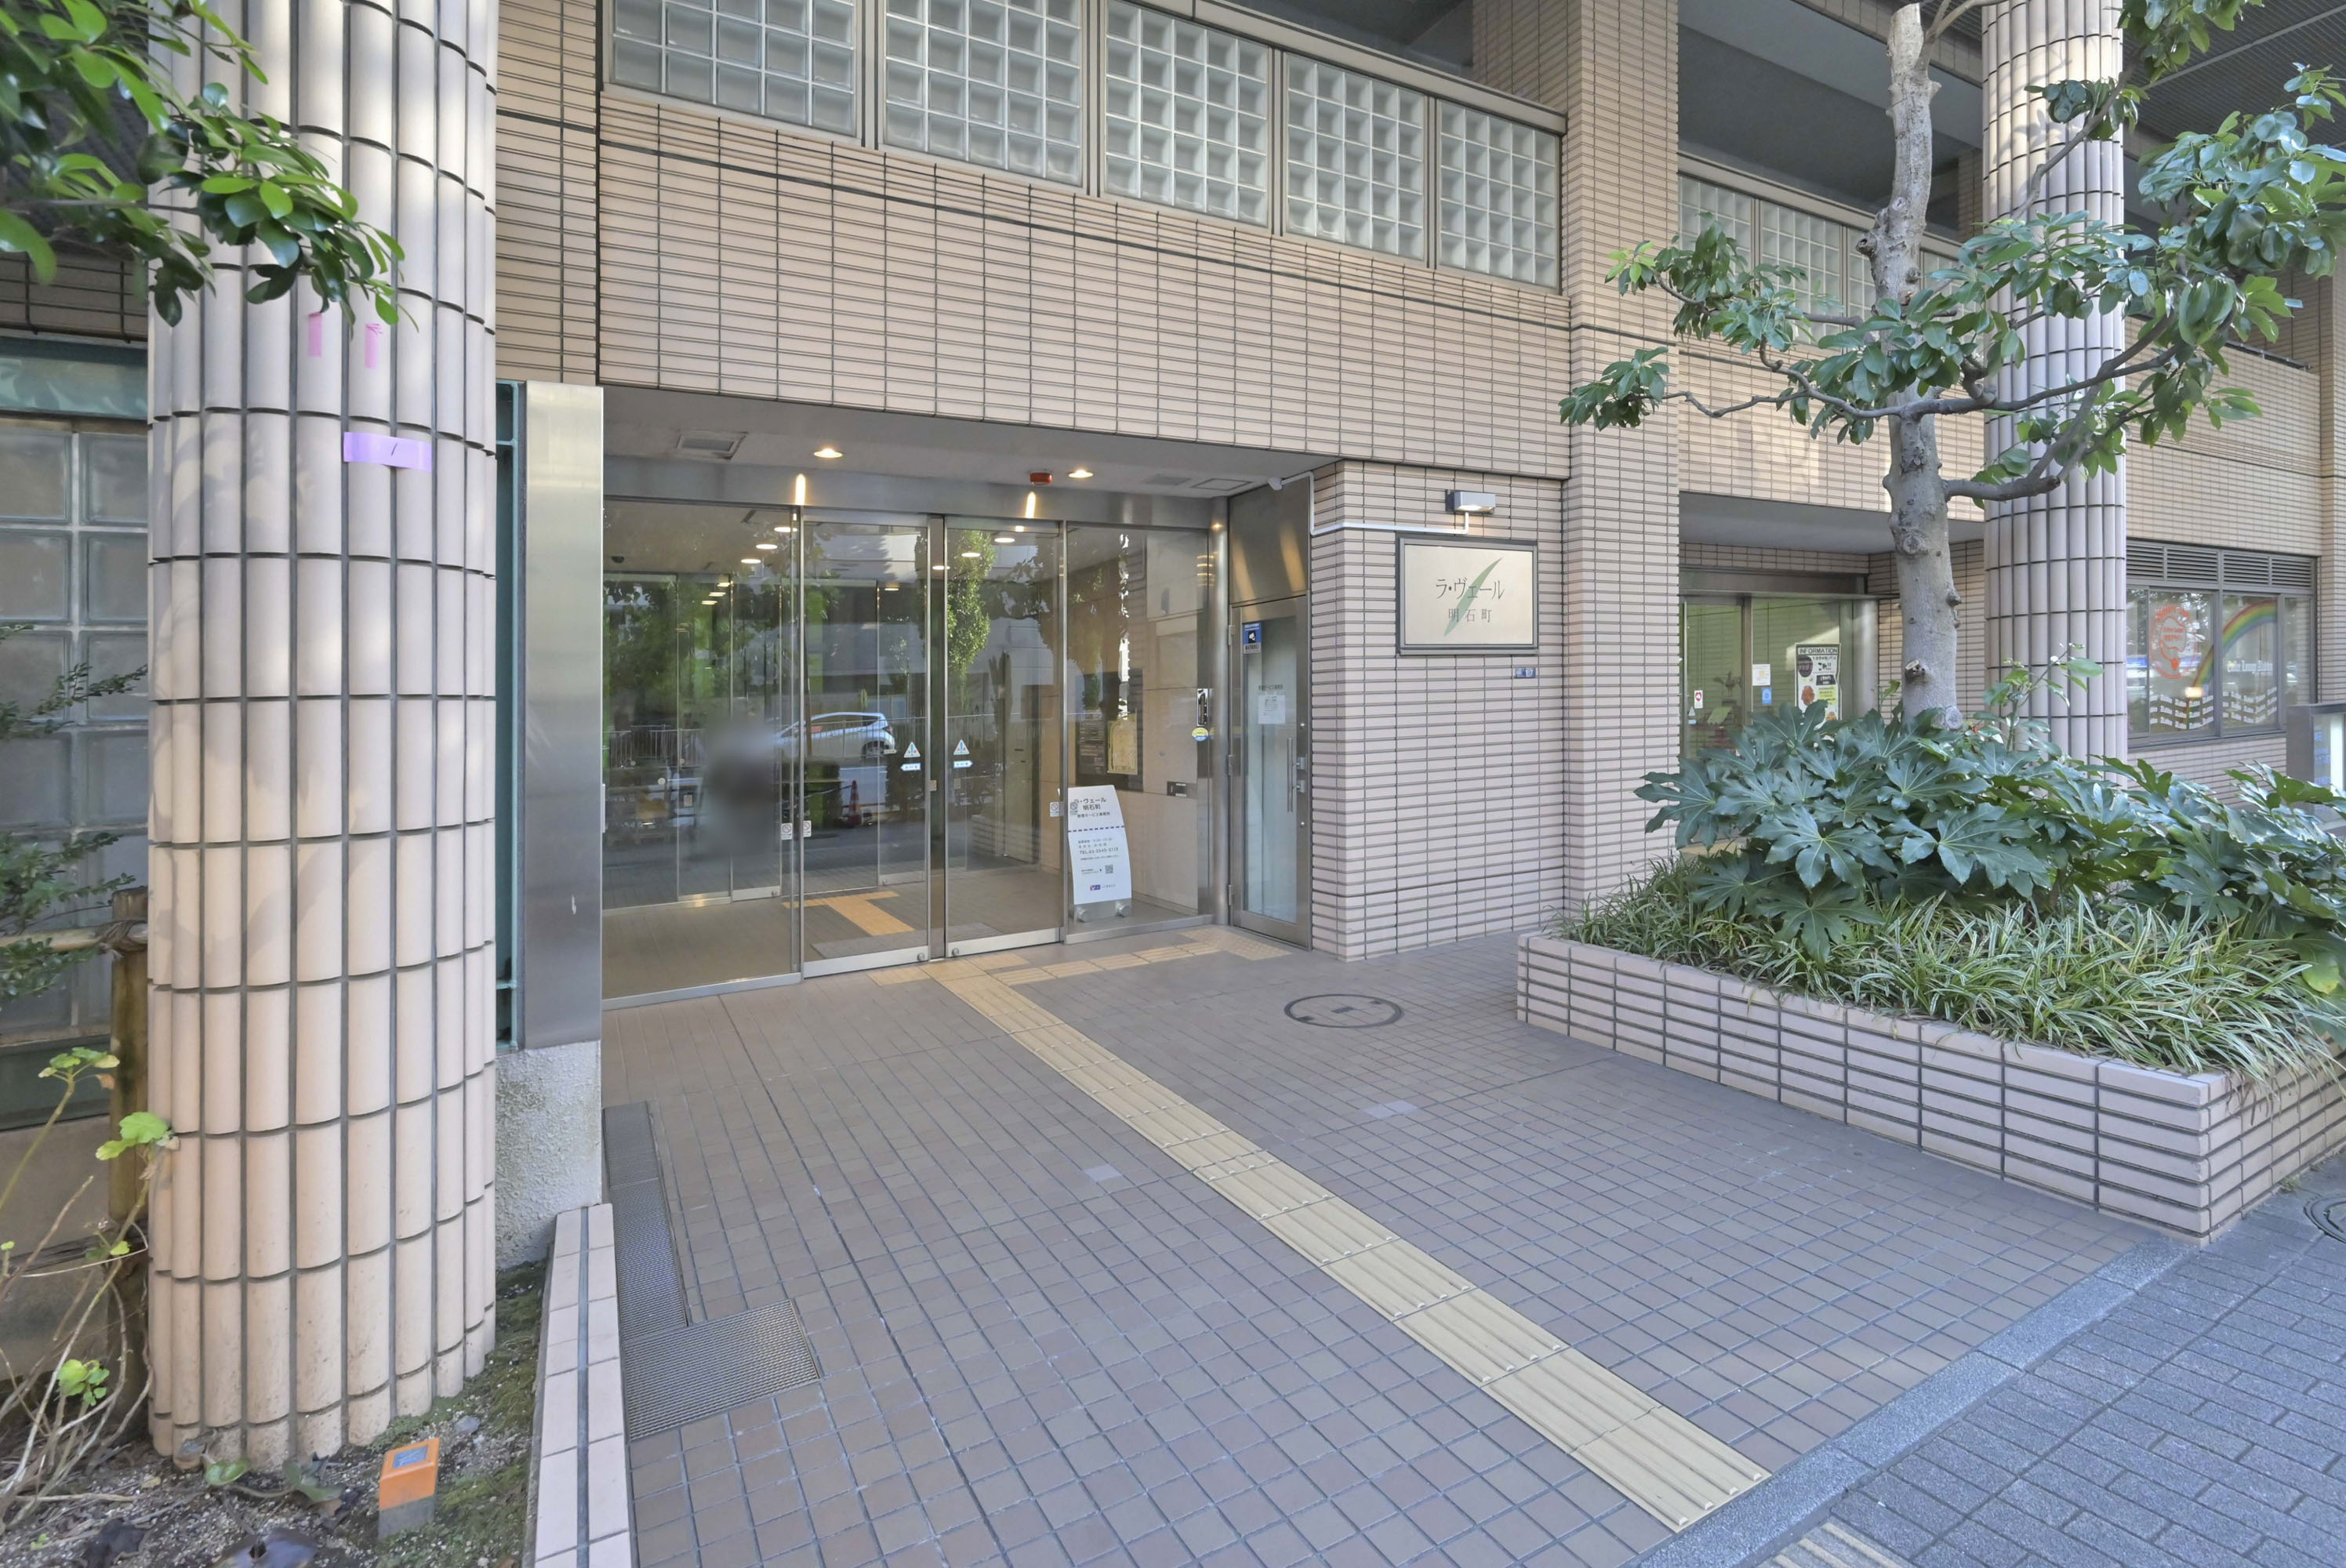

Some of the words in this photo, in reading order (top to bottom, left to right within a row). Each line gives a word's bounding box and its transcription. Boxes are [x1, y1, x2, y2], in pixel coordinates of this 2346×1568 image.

[1436, 577, 1506, 601] ラ・ヴェール
[1448, 608, 1492, 623] 明石町
